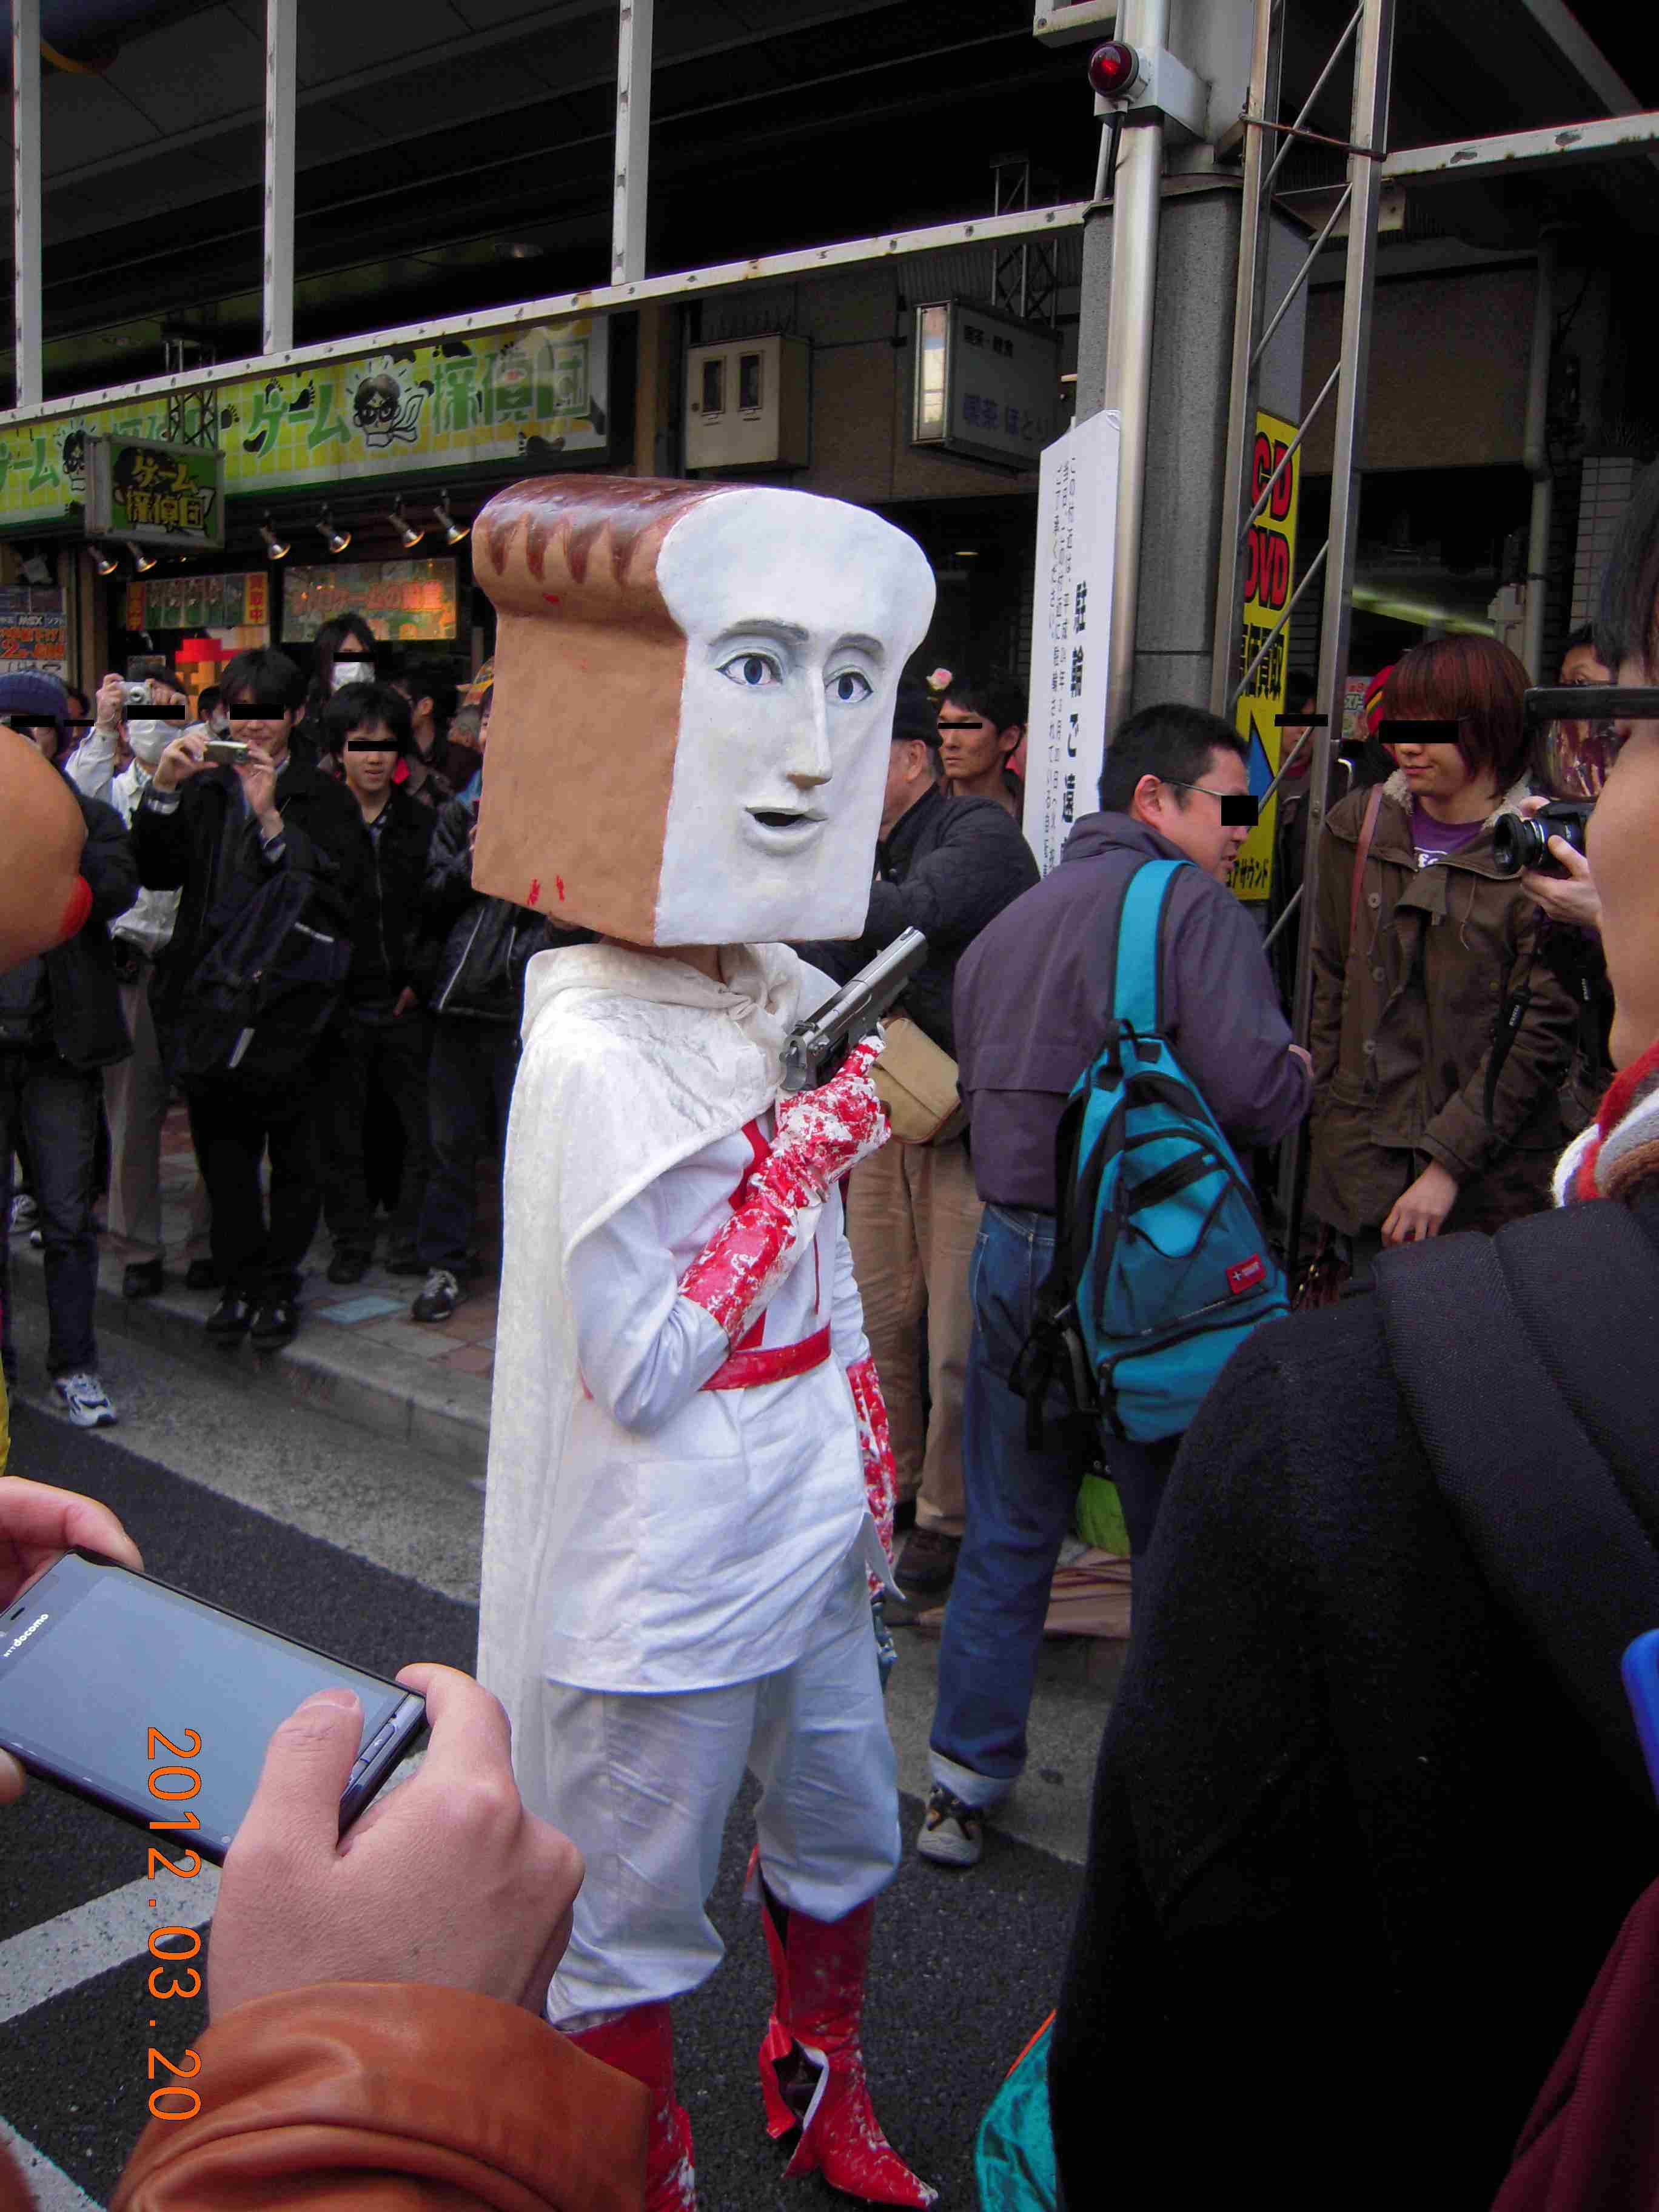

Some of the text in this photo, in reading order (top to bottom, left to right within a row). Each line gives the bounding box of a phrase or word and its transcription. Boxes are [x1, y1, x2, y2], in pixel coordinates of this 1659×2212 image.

[245, 337, 592, 458] ゲーム 探偵団
[0, 437, 60, 492] ーム
[130, 455, 200, 495] ゲーム
[1251, 432, 1293, 523] CD
[126, 490, 207, 530] 探偵団
[1244, 524, 1290, 611] DVD
[14, 1614, 49, 1647] docomo
